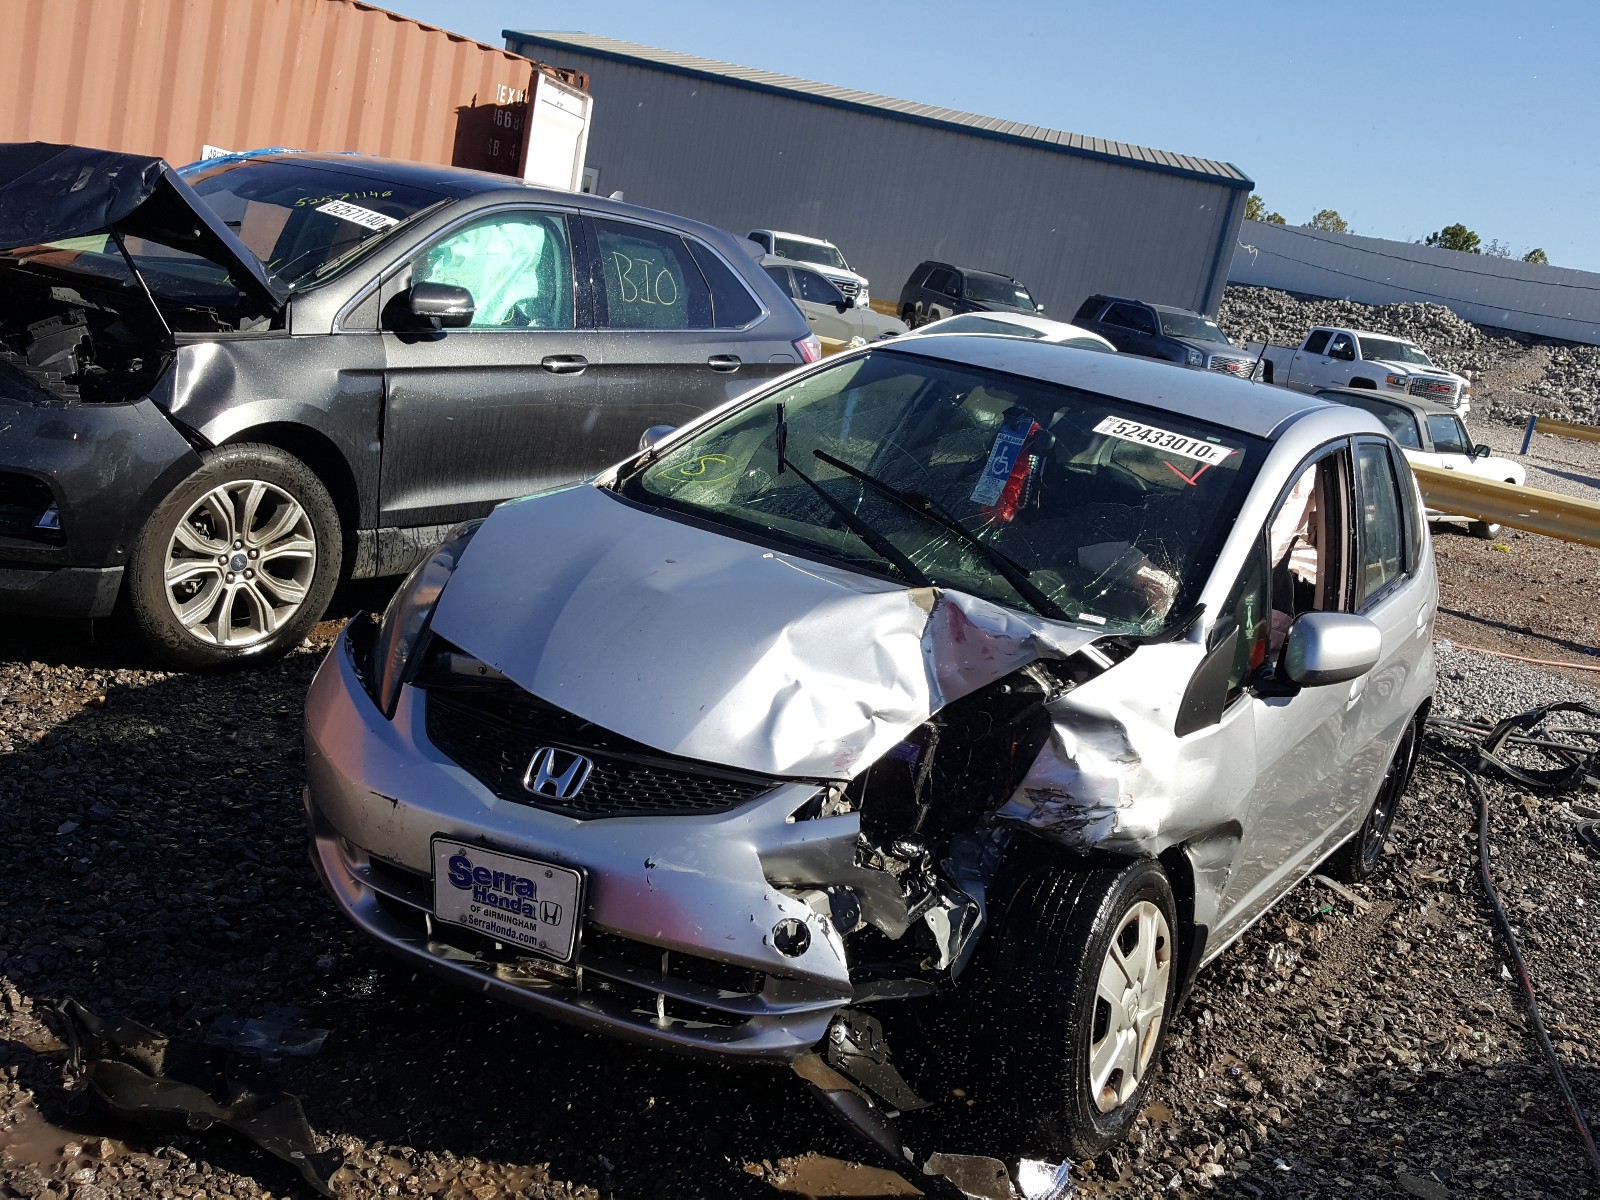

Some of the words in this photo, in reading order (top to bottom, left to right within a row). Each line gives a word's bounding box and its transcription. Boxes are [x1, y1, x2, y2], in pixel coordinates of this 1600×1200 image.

[612, 251, 677, 305] BIO
[1112, 421, 1211, 458] 52433010
[448, 853, 538, 902] Serra
[470, 904, 481, 914] OF
[483, 908, 537, 931] BIRMINGHAM
[472, 885, 538, 920] Honda
[468, 914, 538, 946] SerraHonda.com
